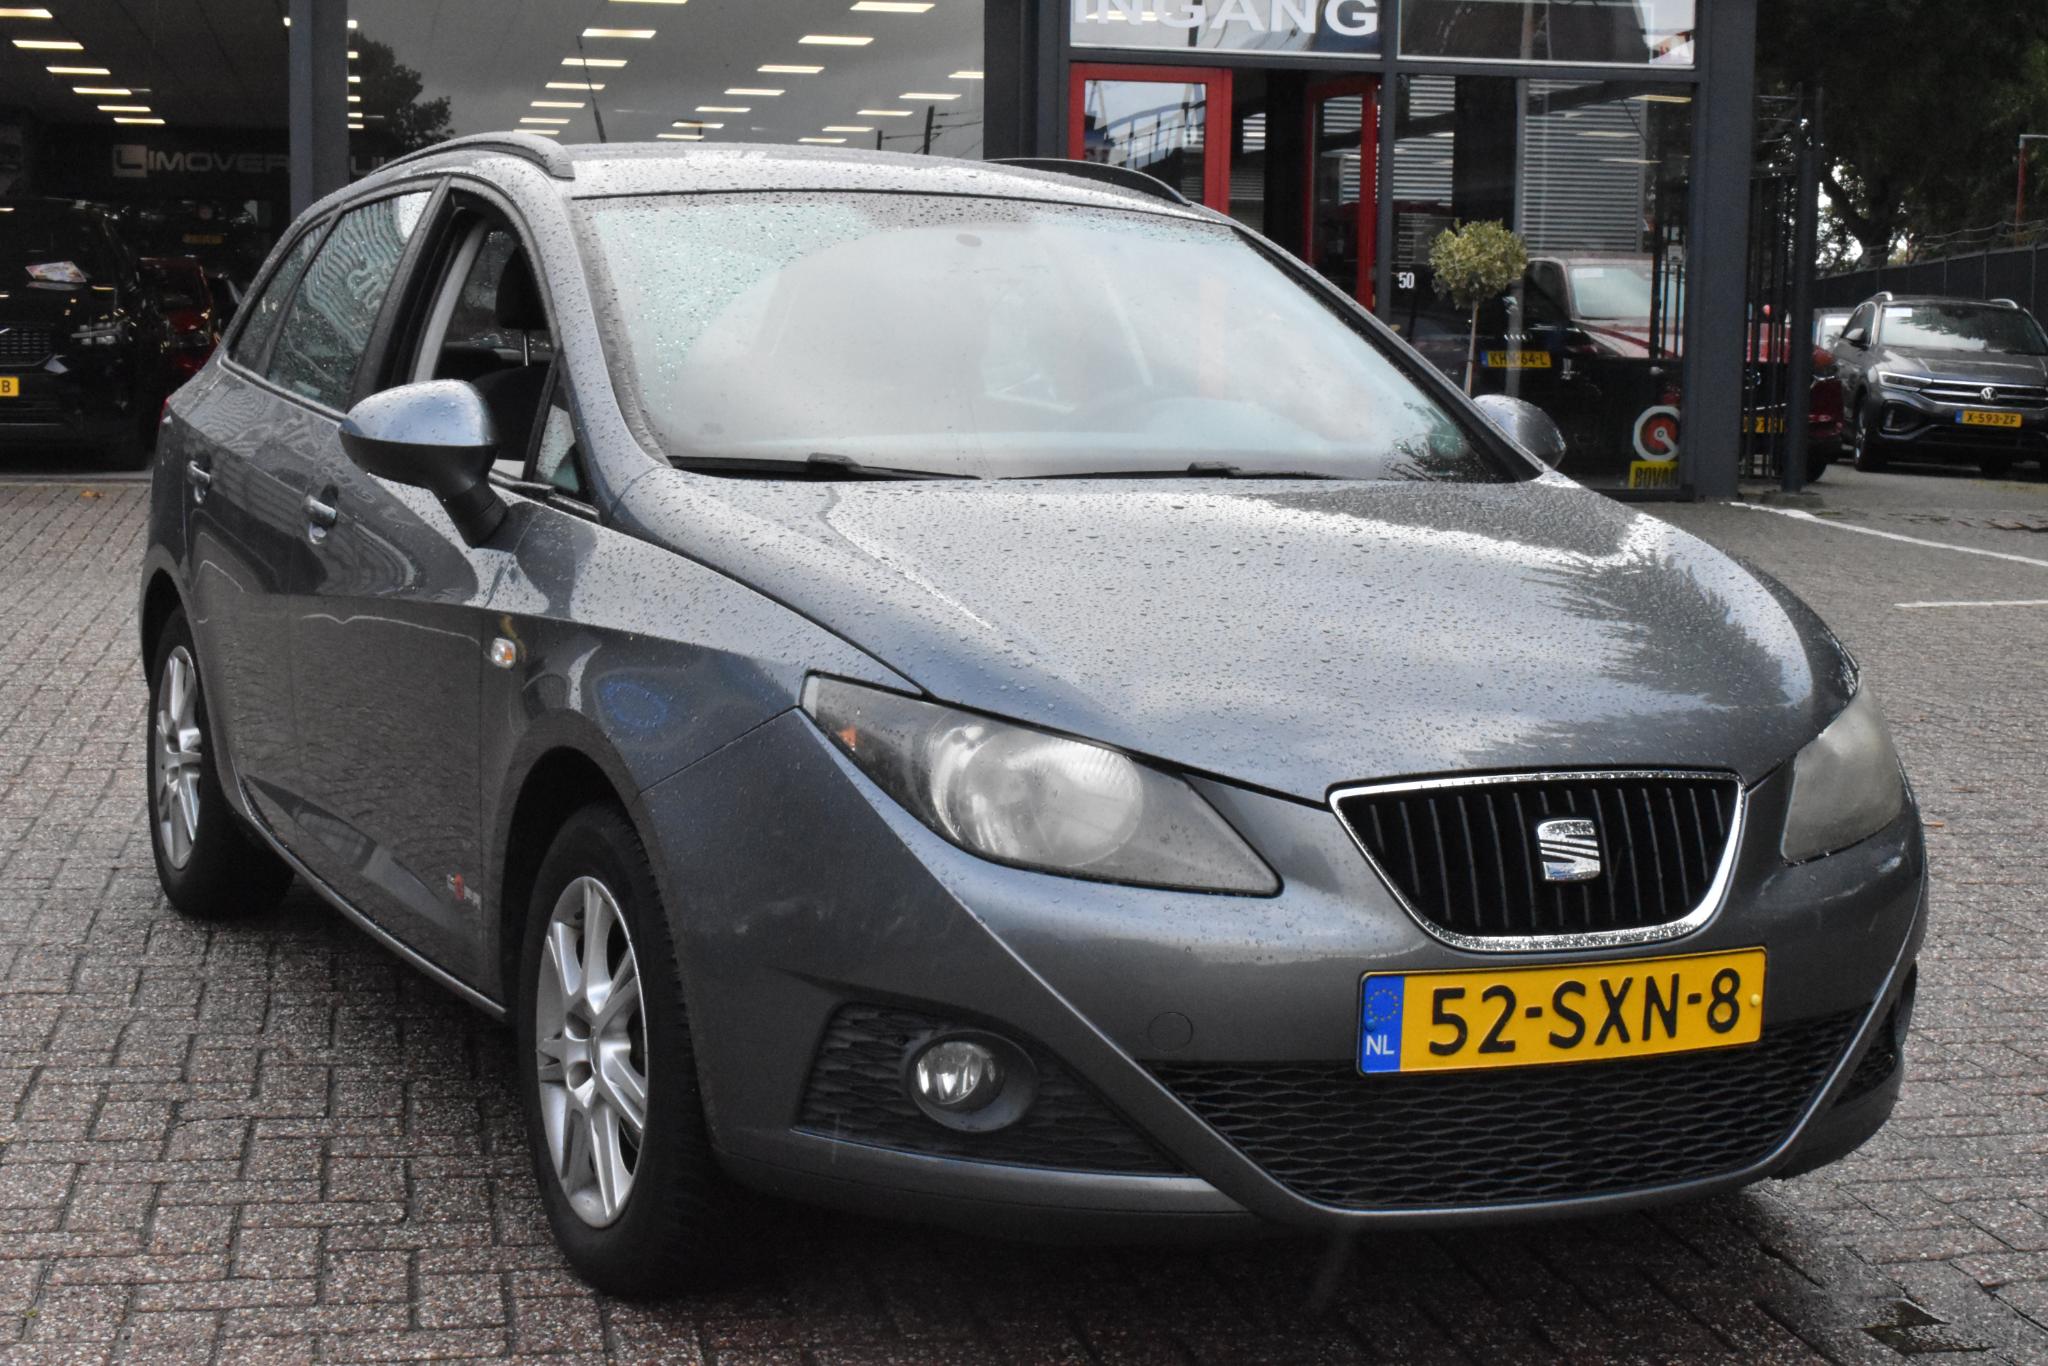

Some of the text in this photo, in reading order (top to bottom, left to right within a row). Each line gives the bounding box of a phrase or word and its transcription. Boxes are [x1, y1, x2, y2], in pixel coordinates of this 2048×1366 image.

[1073, 0, 1379, 36] INGANG
[1398, 272, 1415, 288] 50
[1430, 968, 1741, 1056] 52-SXN-8
[1365, 1036, 1395, 1056] NL
